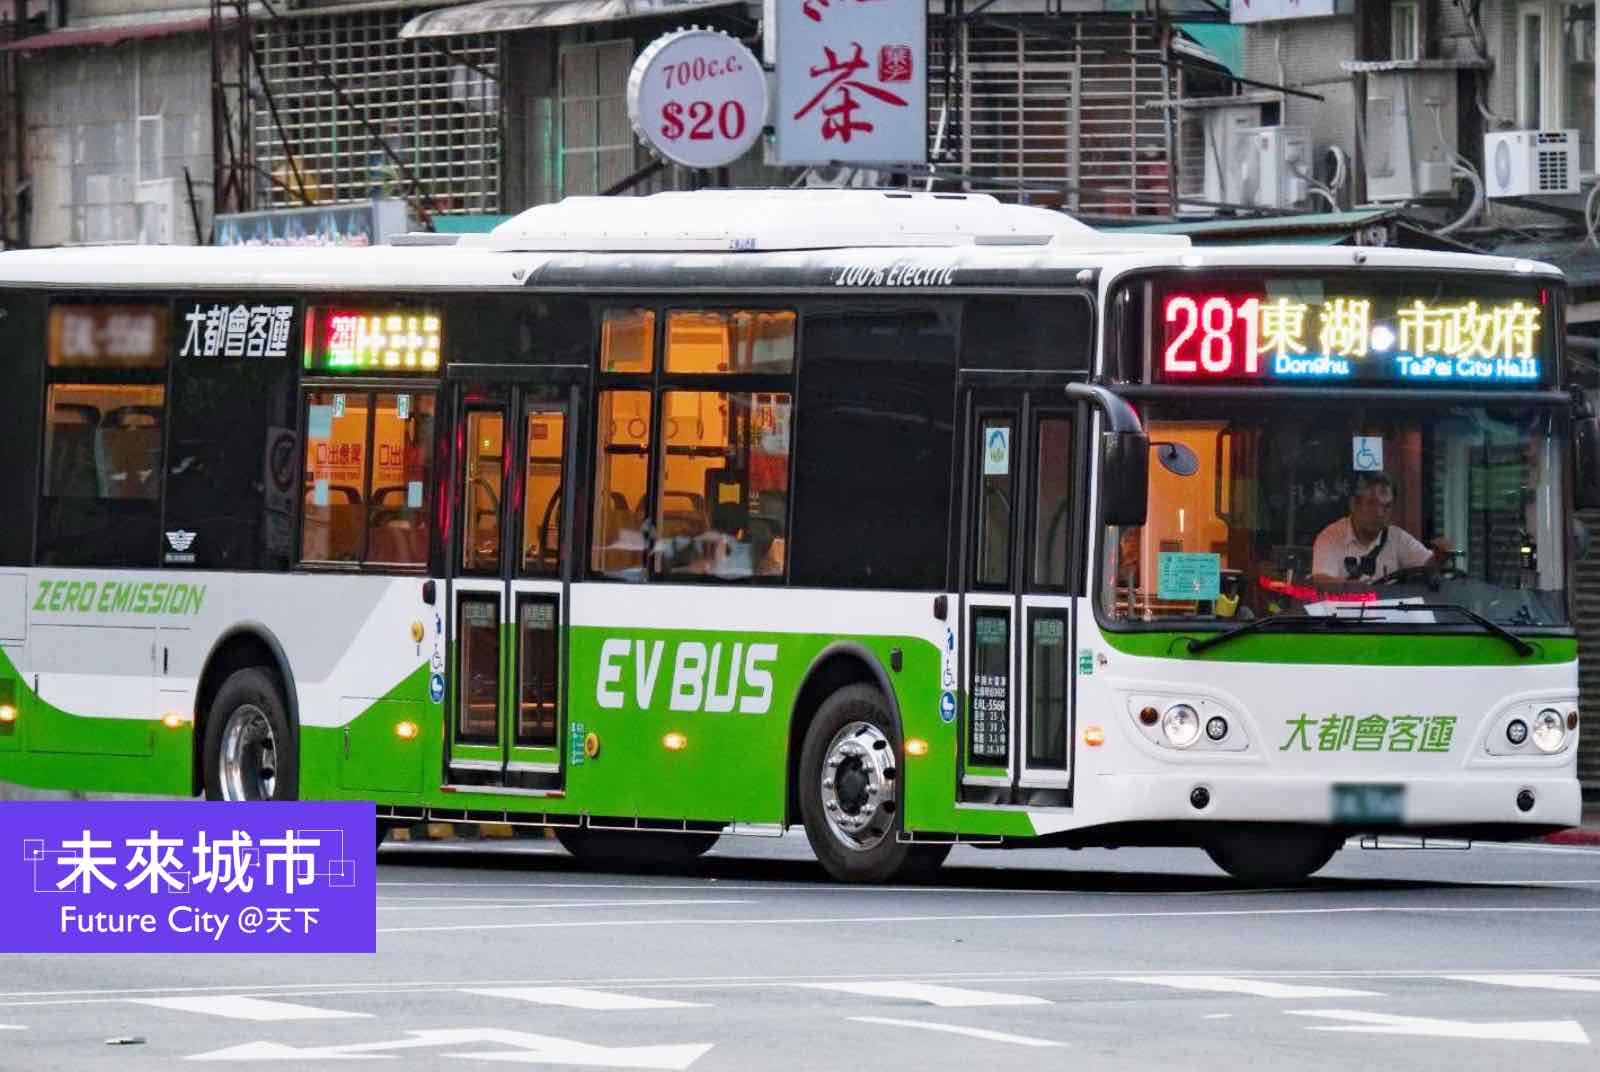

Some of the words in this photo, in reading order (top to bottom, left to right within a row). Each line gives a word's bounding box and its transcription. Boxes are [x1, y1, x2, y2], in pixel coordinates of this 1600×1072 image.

[663, 55, 743, 90] 700c.c.
[794, 0, 908, 143] 茶
[661, 100, 745, 140] $20
[835, 264, 885, 286] 100%
[886, 263, 958, 286] Electric
[179, 303, 294, 357] 大都會客運
[1165, 297, 1258, 373] 281
[1257, 297, 1370, 357] 東湖
[1397, 299, 1541, 359] 市政府
[1456, 358, 1493, 377] City
[1496, 358, 1537, 377] Hall
[32, 579, 97, 613] ZERO
[97, 580, 208, 615] EMISSION
[596, 638, 665, 709] EV
[669, 641, 779, 714] BUS
[1279, 713, 1457, 752] 大都會客運
